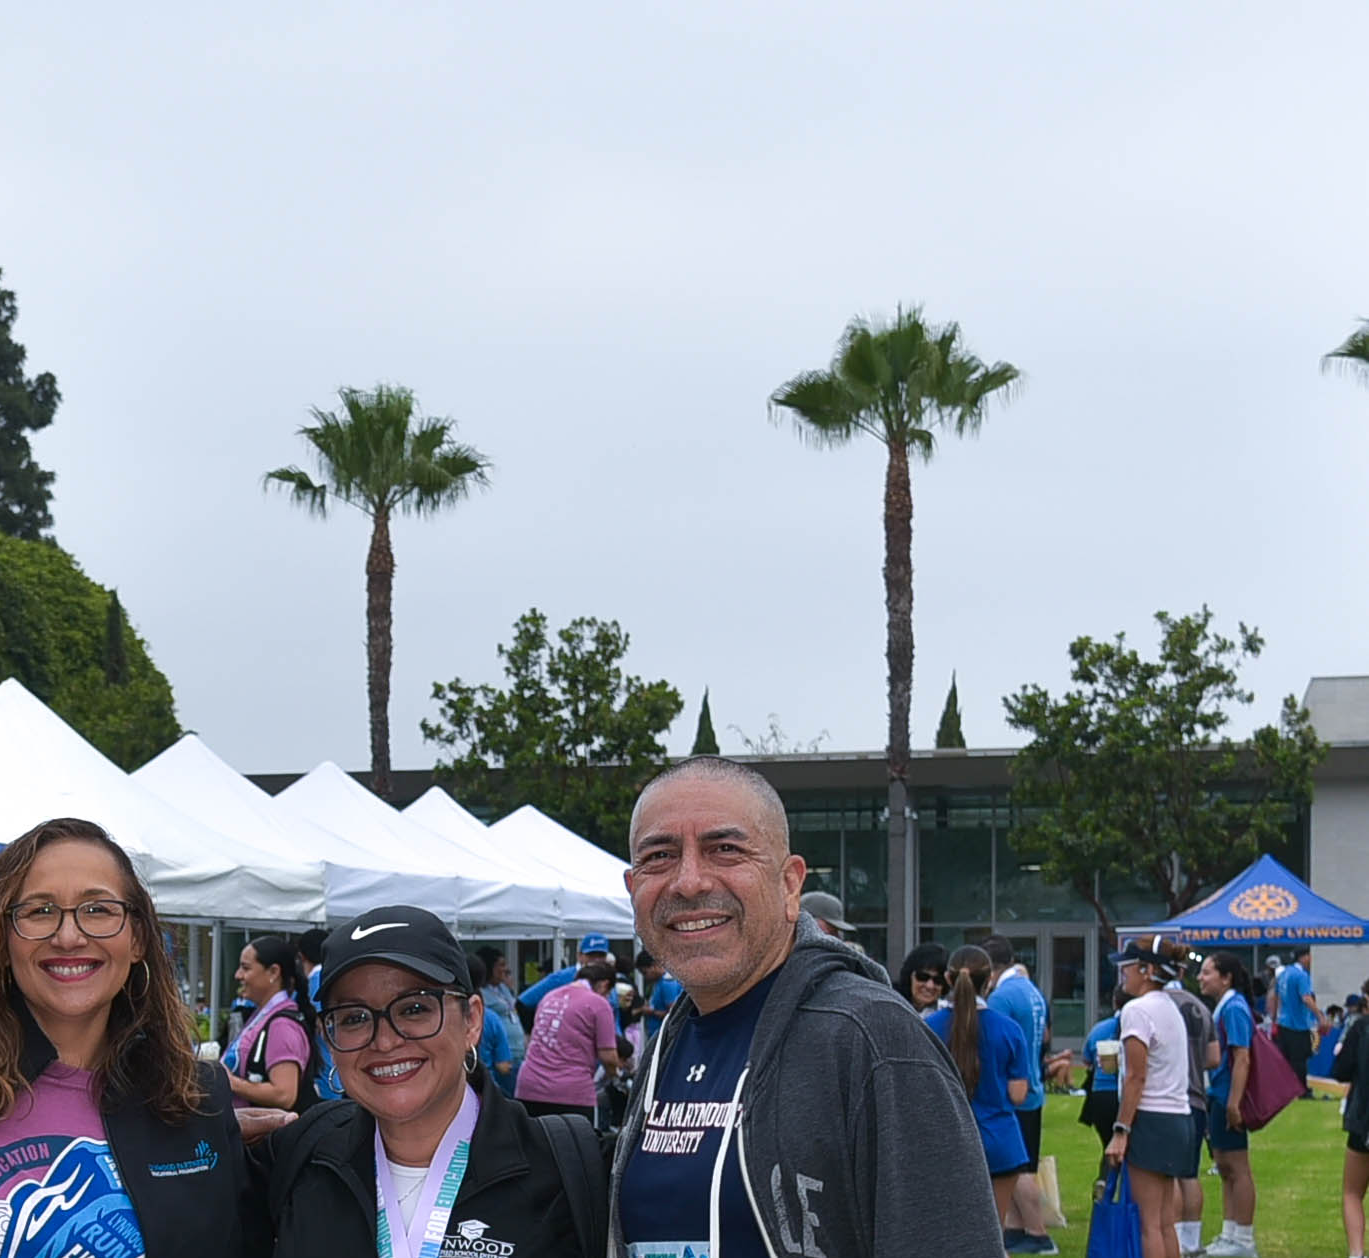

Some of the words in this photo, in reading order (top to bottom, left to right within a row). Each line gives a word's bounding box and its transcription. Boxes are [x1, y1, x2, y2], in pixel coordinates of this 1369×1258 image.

[1223, 927, 1262, 939] CLUB
[1263, 926, 1285, 939] OF
[1287, 926, 1364, 938] LYNWOOD
[641, 1128, 705, 1154] UNIVERSITY
[434, 1139, 471, 1209] EDUCATION
[423, 1206, 452, 1242] FOR
